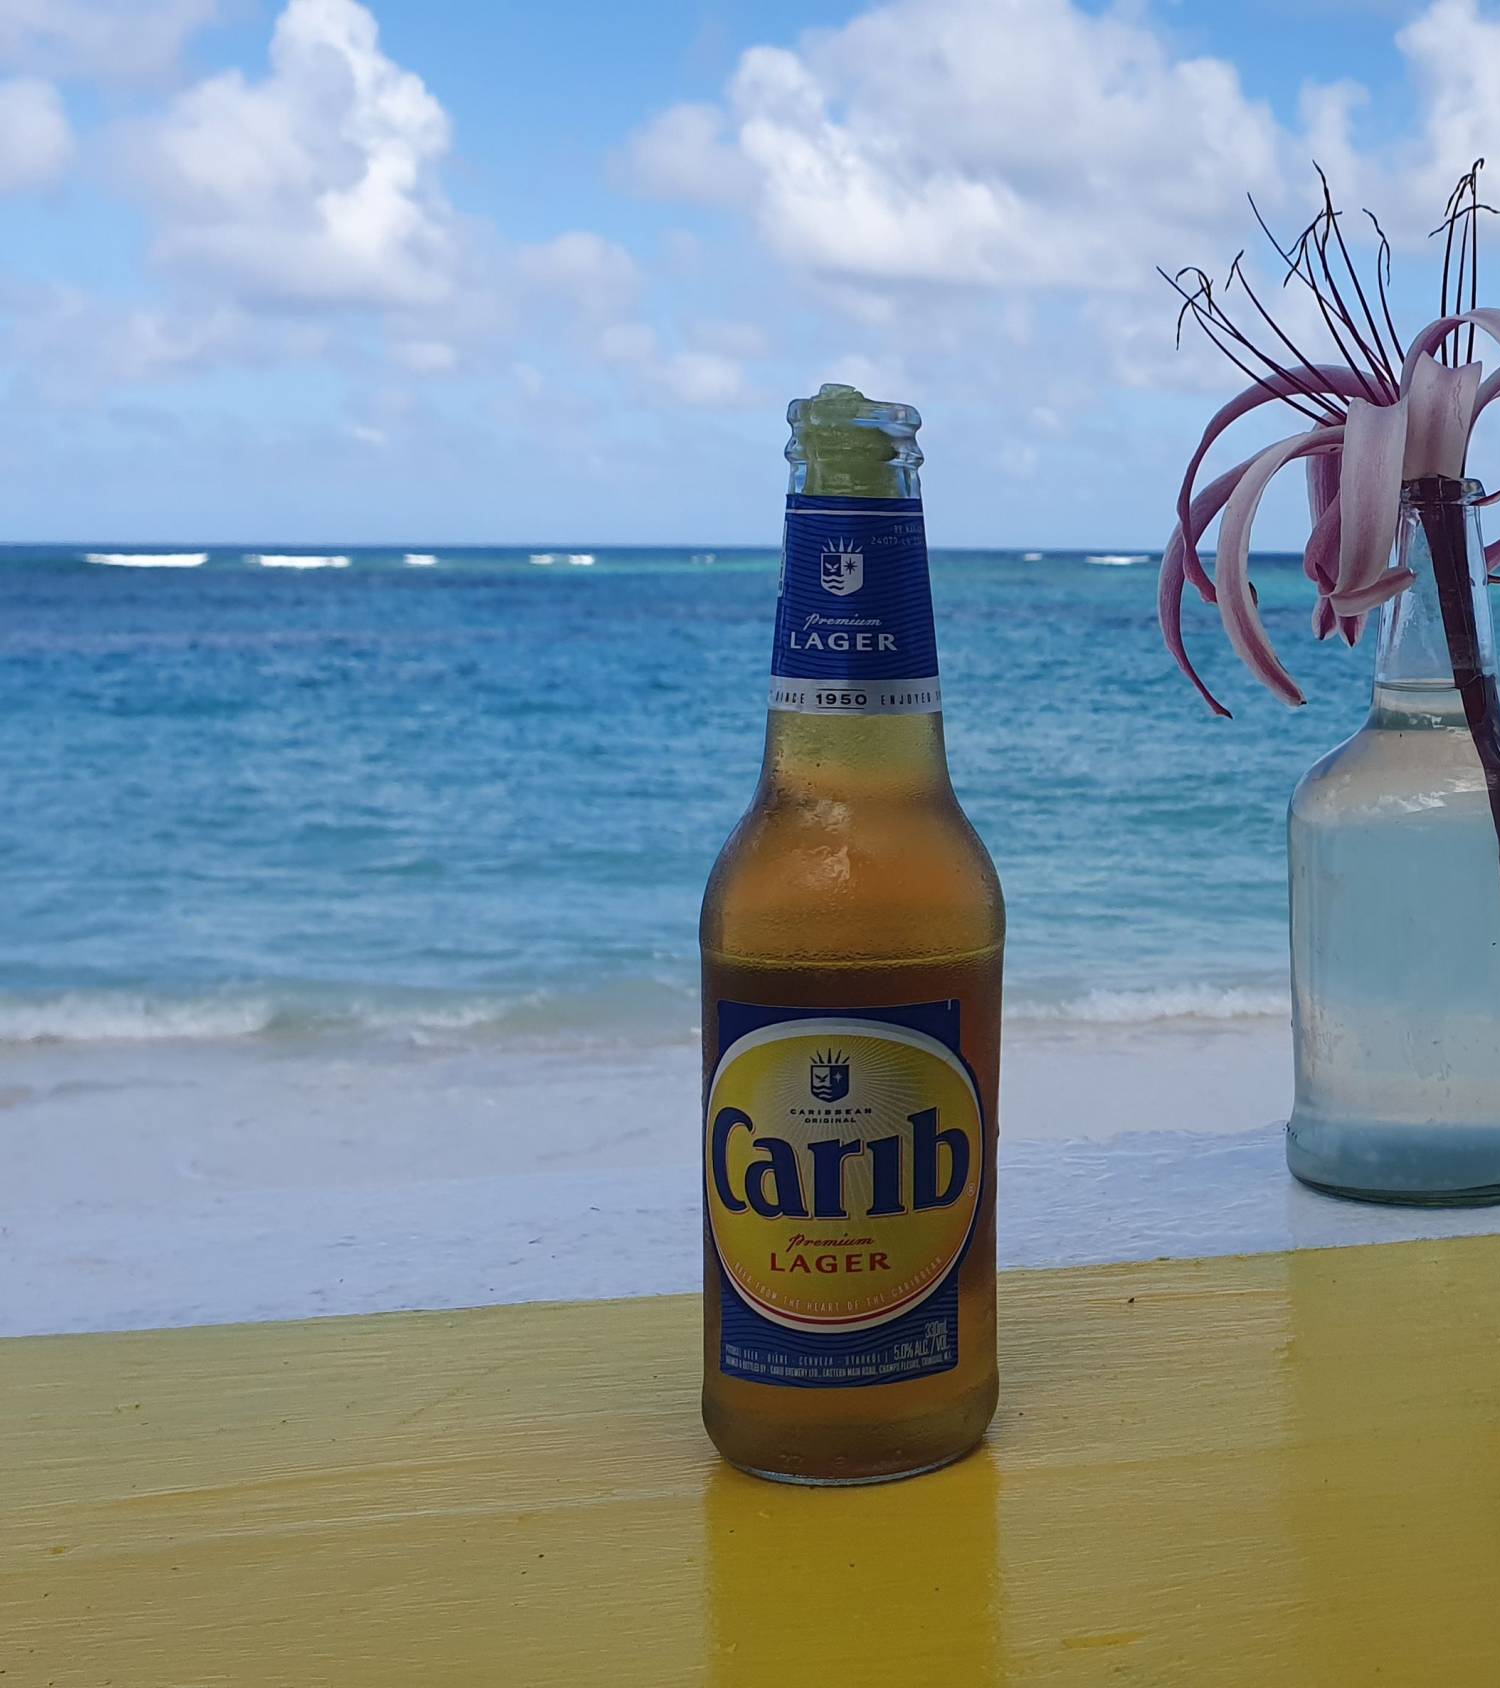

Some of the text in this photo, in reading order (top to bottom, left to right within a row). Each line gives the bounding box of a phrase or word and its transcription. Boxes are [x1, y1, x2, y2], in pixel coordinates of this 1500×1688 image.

[790, 632, 897, 651] LAGER
[815, 693, 868, 705] 1950
[790, 1108, 872, 1116] CARIBBEAN
[770, 1252, 891, 1273] LAGER
[807, 1302, 839, 1312] HEART
